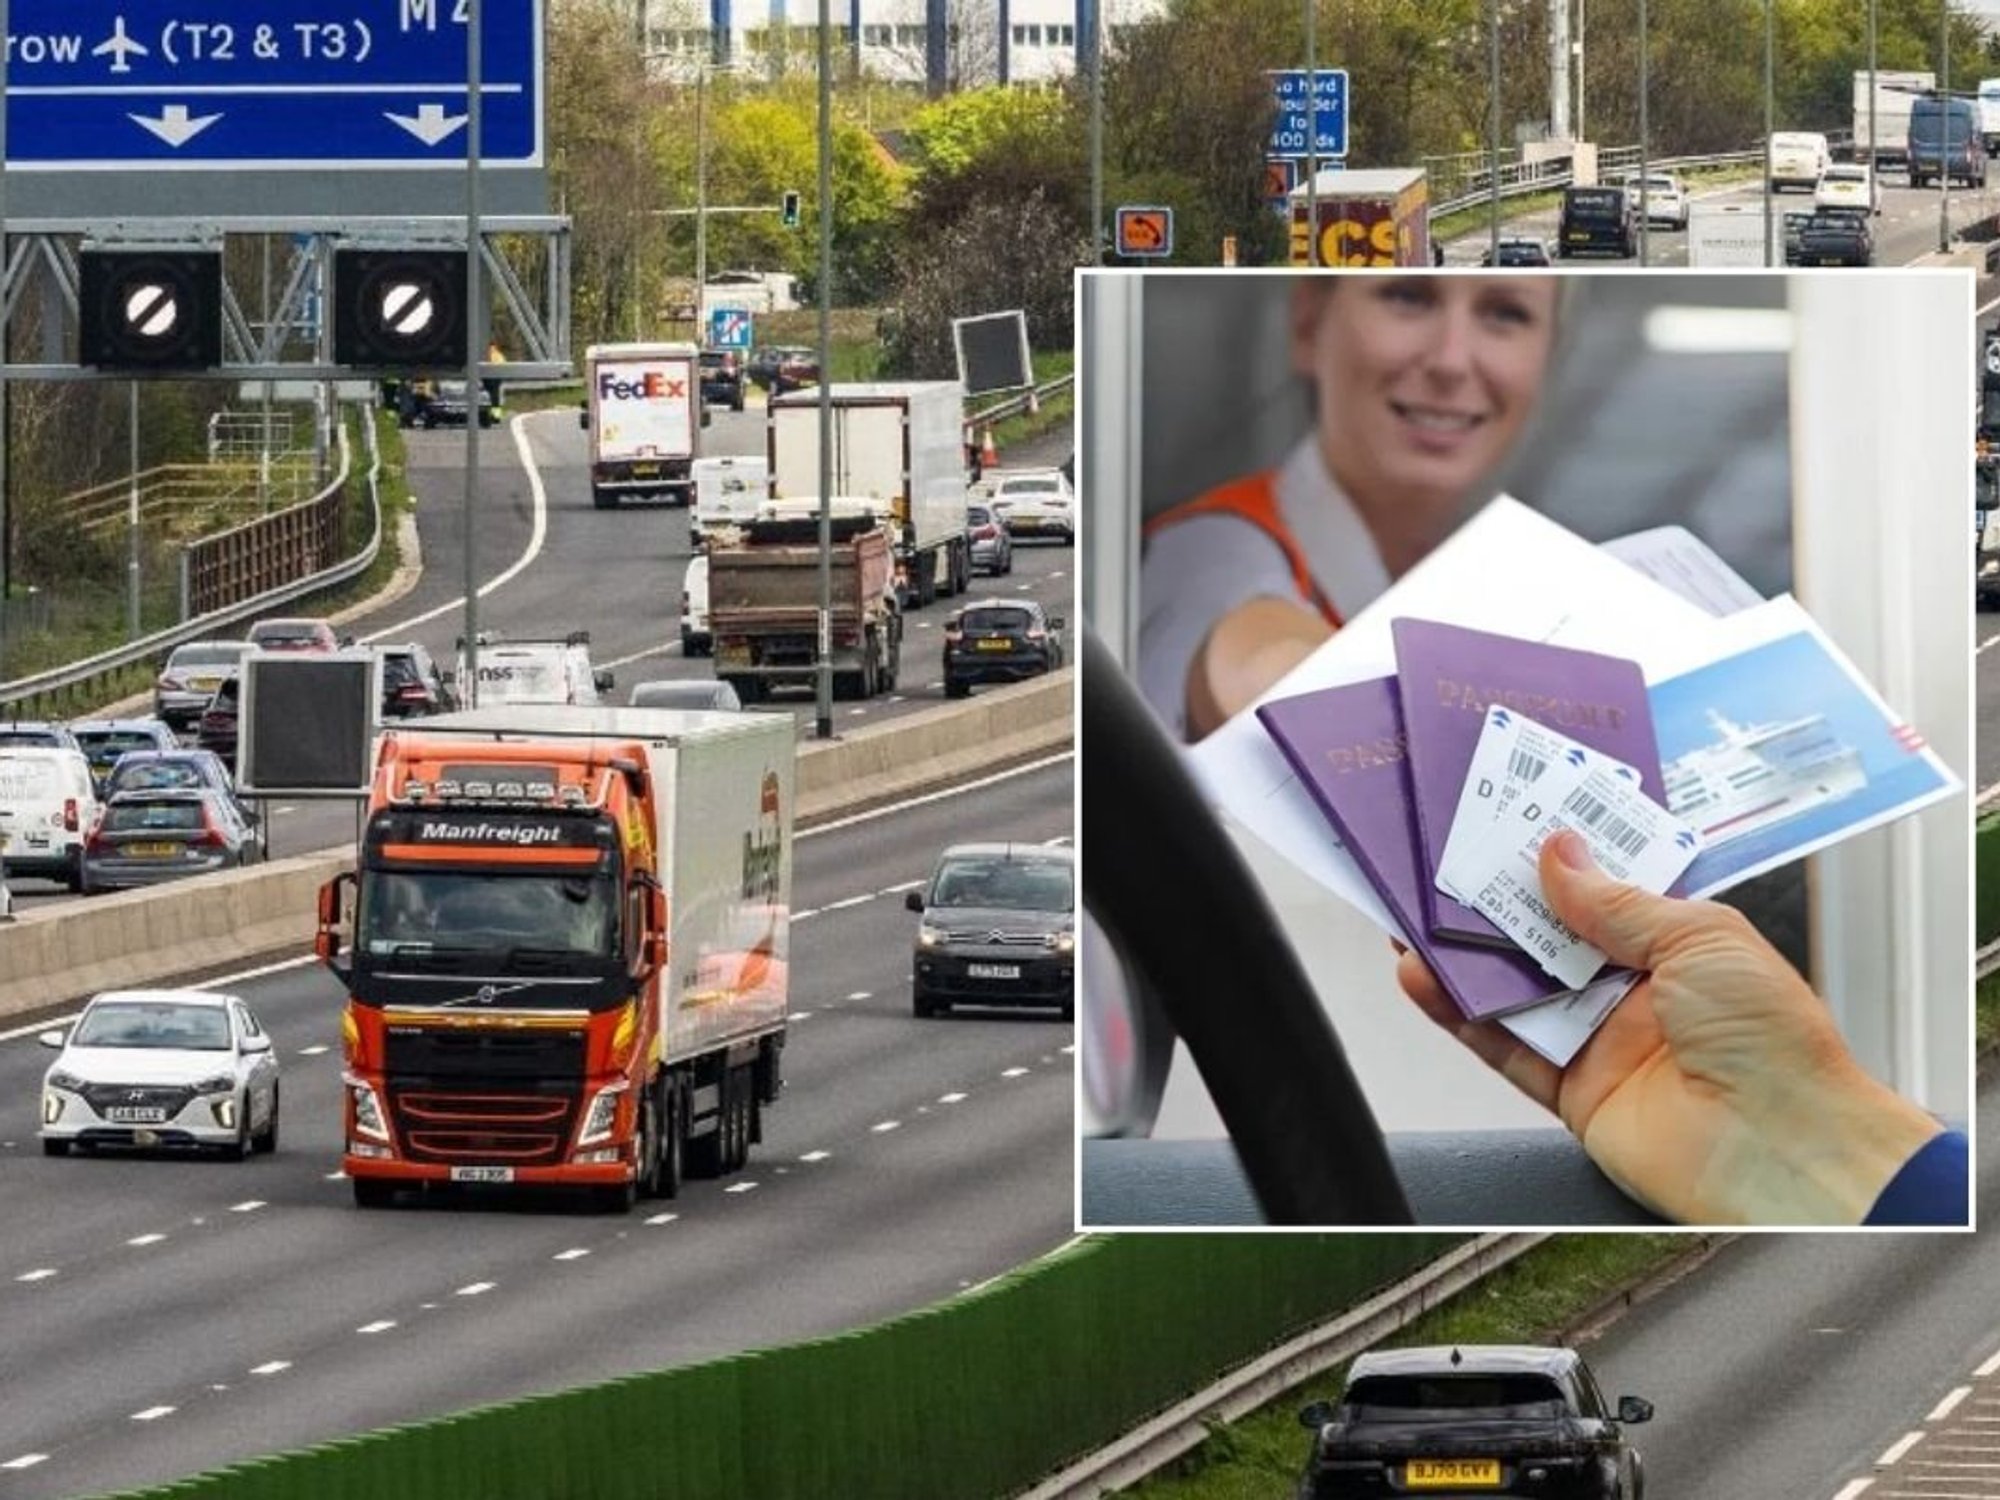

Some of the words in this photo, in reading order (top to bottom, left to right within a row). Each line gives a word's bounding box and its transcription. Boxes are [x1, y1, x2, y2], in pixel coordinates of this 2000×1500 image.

[161, 20, 235, 63] (T2
[252, 28, 279, 58] &
[294, 20, 373, 63] T3)
[600, 372, 685, 400] FedEx
[1478, 779, 1494, 798] D
[1523, 803, 1543, 822] D
[421, 822, 561, 845] Manfreight
[1478, 888, 1520, 927] Cabin
